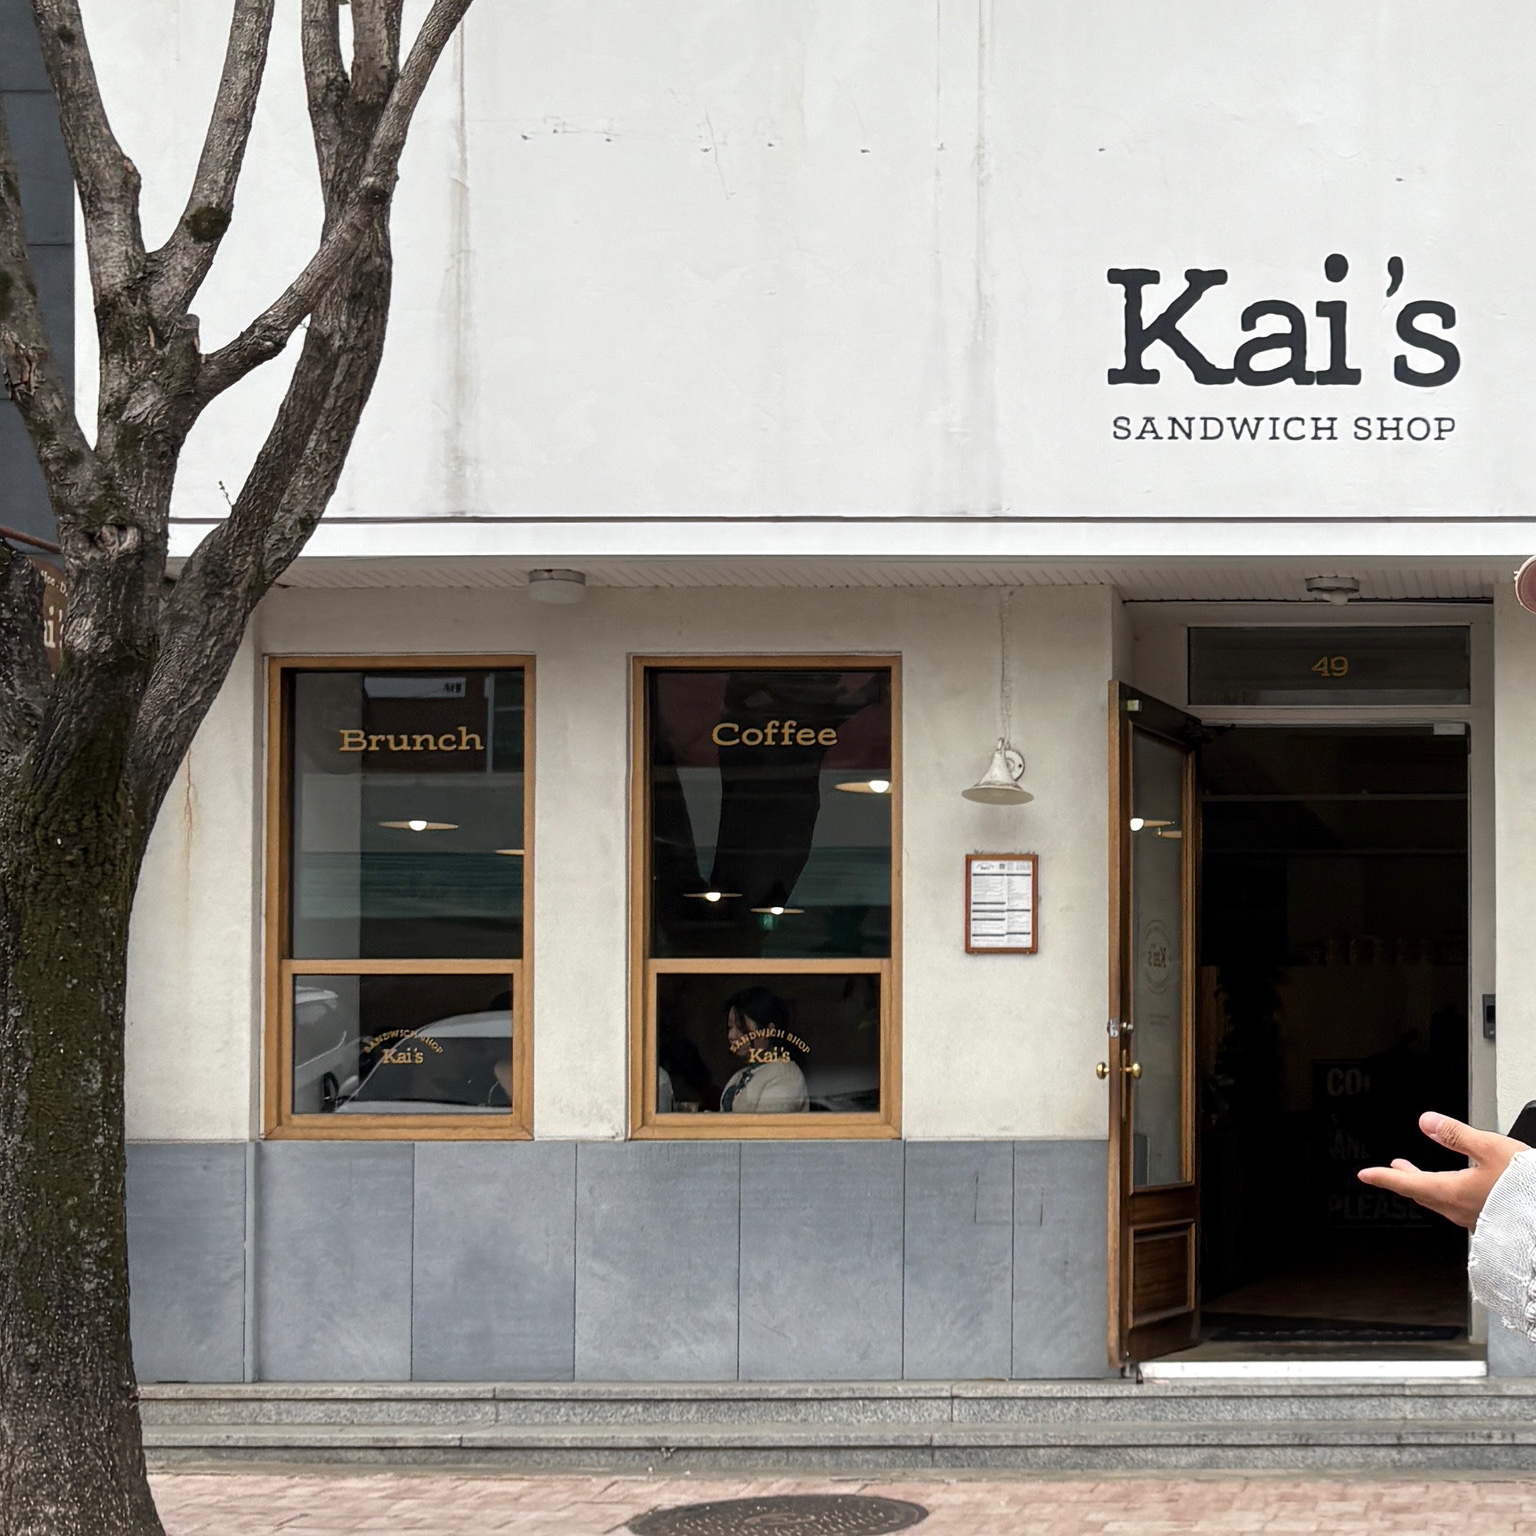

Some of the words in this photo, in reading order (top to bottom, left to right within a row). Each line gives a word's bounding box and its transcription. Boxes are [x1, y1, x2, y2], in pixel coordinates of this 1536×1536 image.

[1106, 252, 1461, 388] Kai's
[1112, 415, 1339, 441] SANDWICH
[1353, 415, 1456, 441] SHOP
[1311, 655, 1349, 677] 49
[339, 726, 485, 751] Brunch
[711, 719, 838, 746] Coffee
[729, 1027, 786, 1053] SANDWICH
[786, 1033, 811, 1053] SHOP
[382, 1047, 424, 1064] Kai's
[748, 1046, 791, 1064] Kai's
